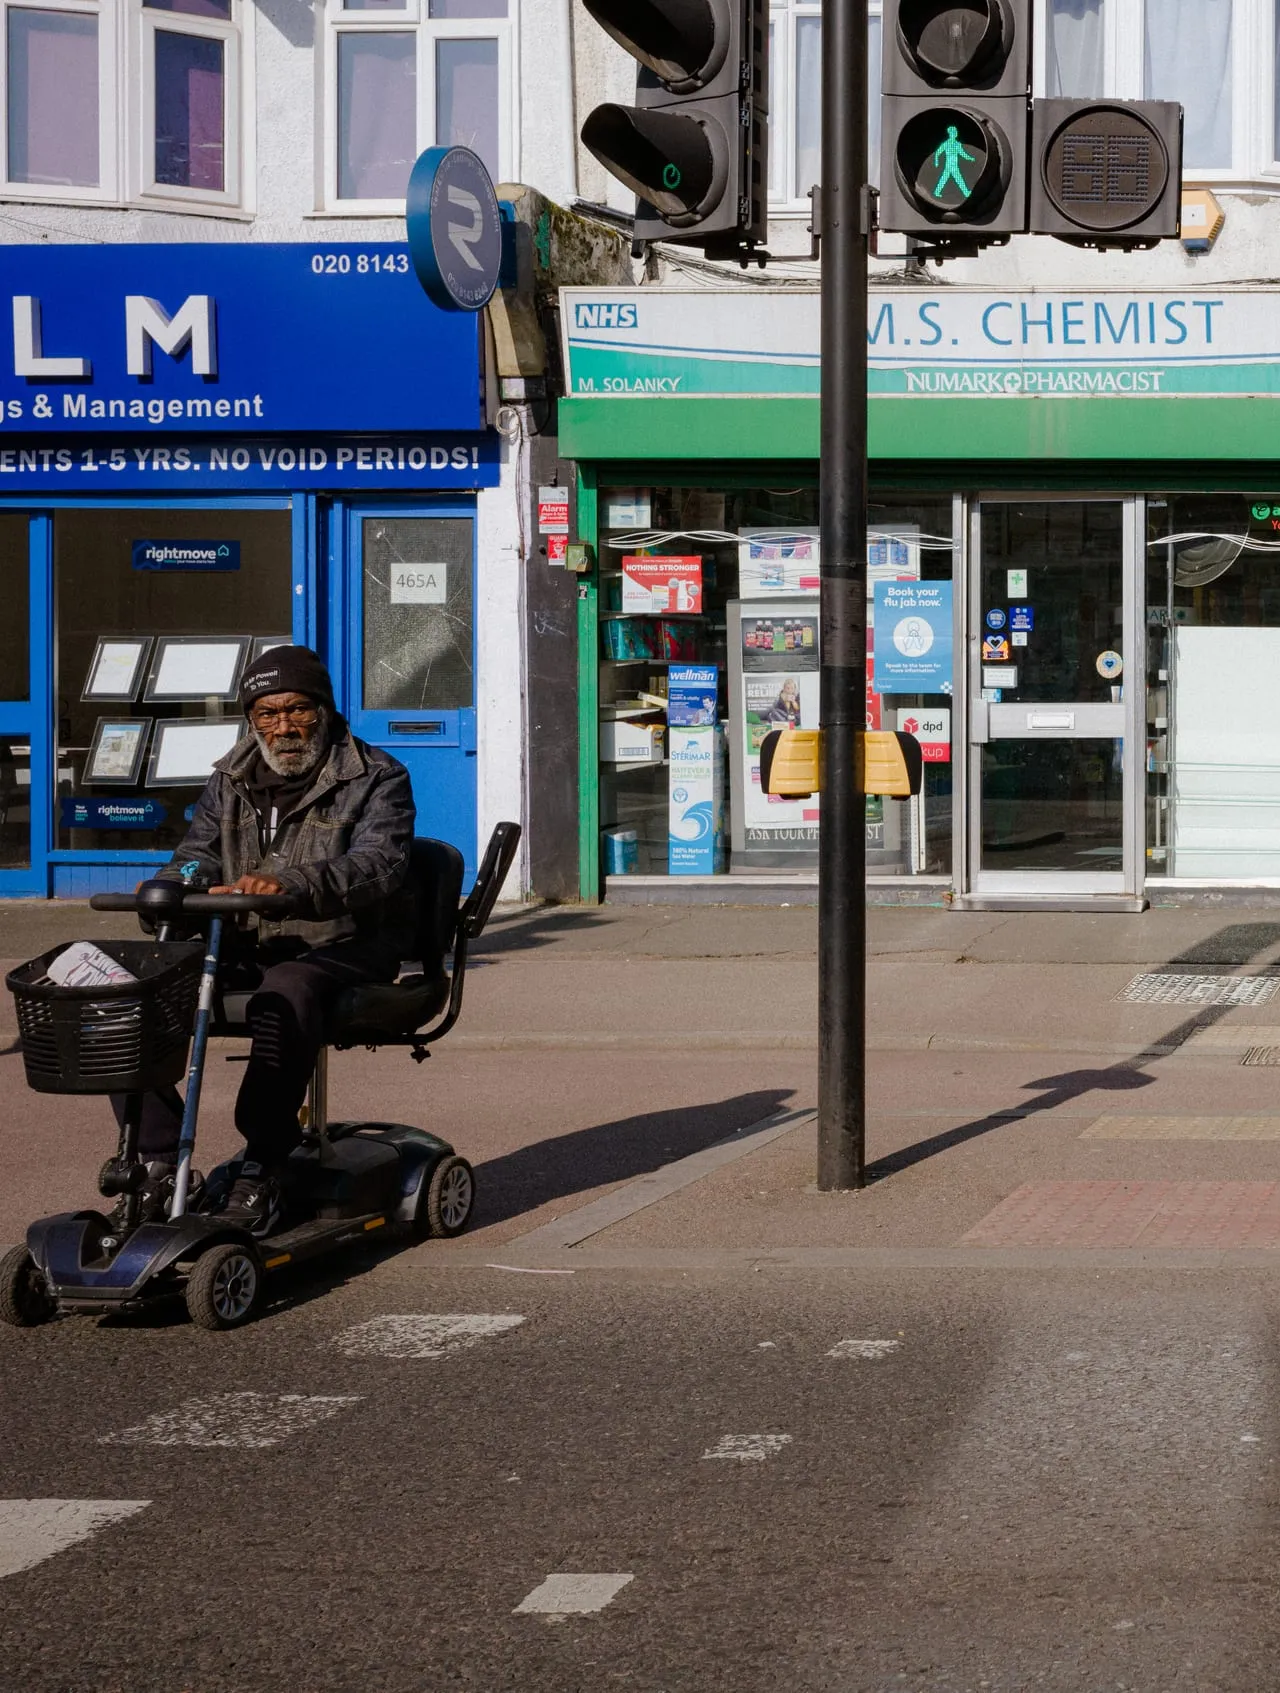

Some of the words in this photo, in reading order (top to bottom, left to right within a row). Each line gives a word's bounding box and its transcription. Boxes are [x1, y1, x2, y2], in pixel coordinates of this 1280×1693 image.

[311, 254, 351, 274] 020
[357, 253, 409, 273] 8143
[577, 304, 637, 327] NHS
[982, 300, 1223, 345] CHEMIST
[13, 295, 91, 377] L
[125, 295, 217, 376] M
[579, 378, 598, 392] M.
[603, 376, 682, 392] SOLANKY
[33, 394, 54, 419] &
[64, 394, 264, 423] Management
[81, 448, 127, 471] 1-5
[132, 448, 200, 471] YRS.
[210, 448, 250, 470] NO
[259, 447, 327, 471] VOID
[336, 446, 480, 470] PERIODS!
[146, 546, 216, 562] rightmove
[660, 564, 700, 572] STRONGER
[396, 574, 437, 588] 465A
[888, 587, 914, 597] Book
[916, 588, 940, 598] your
[883, 597, 898, 607] flu
[900, 597, 917, 608] jab
[671, 669, 715, 681] wellman
[922, 721, 943, 733] dpd
[98, 805, 144, 816] rightmove
